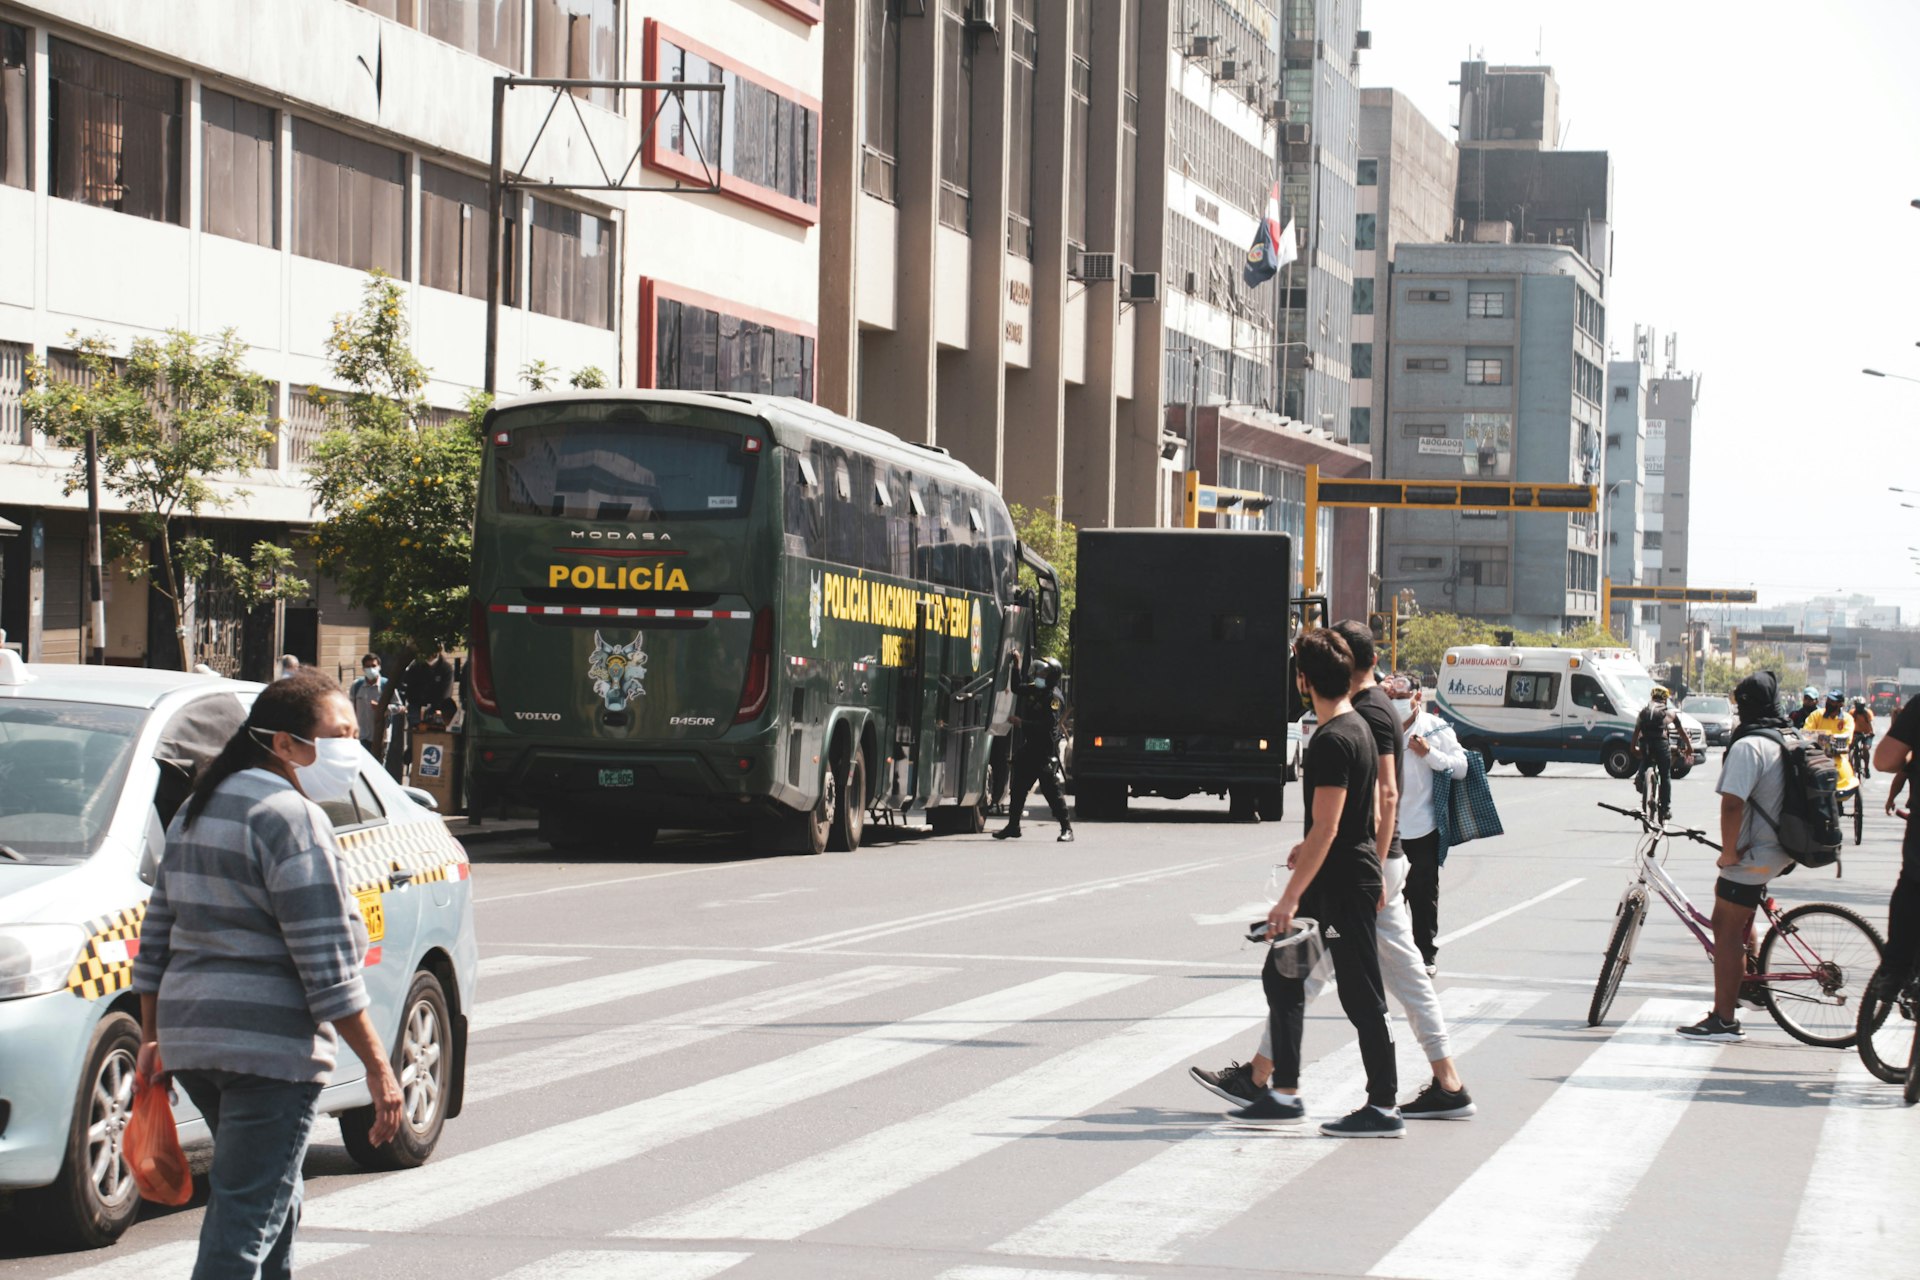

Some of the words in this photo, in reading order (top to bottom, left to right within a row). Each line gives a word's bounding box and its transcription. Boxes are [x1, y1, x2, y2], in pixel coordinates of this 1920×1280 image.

[1420, 438, 1462, 448] ABOGADOS
[570, 530, 672, 541] MODASA
[549, 563, 690, 592] POLICÍA
[824, 568, 869, 623] POLICÍA
[1460, 658, 1508, 667] AMBULANCIA
[1467, 684, 1504, 697] EsSalud
[514, 711, 562, 722] VOLVO
[669, 716, 715, 727] B450R
